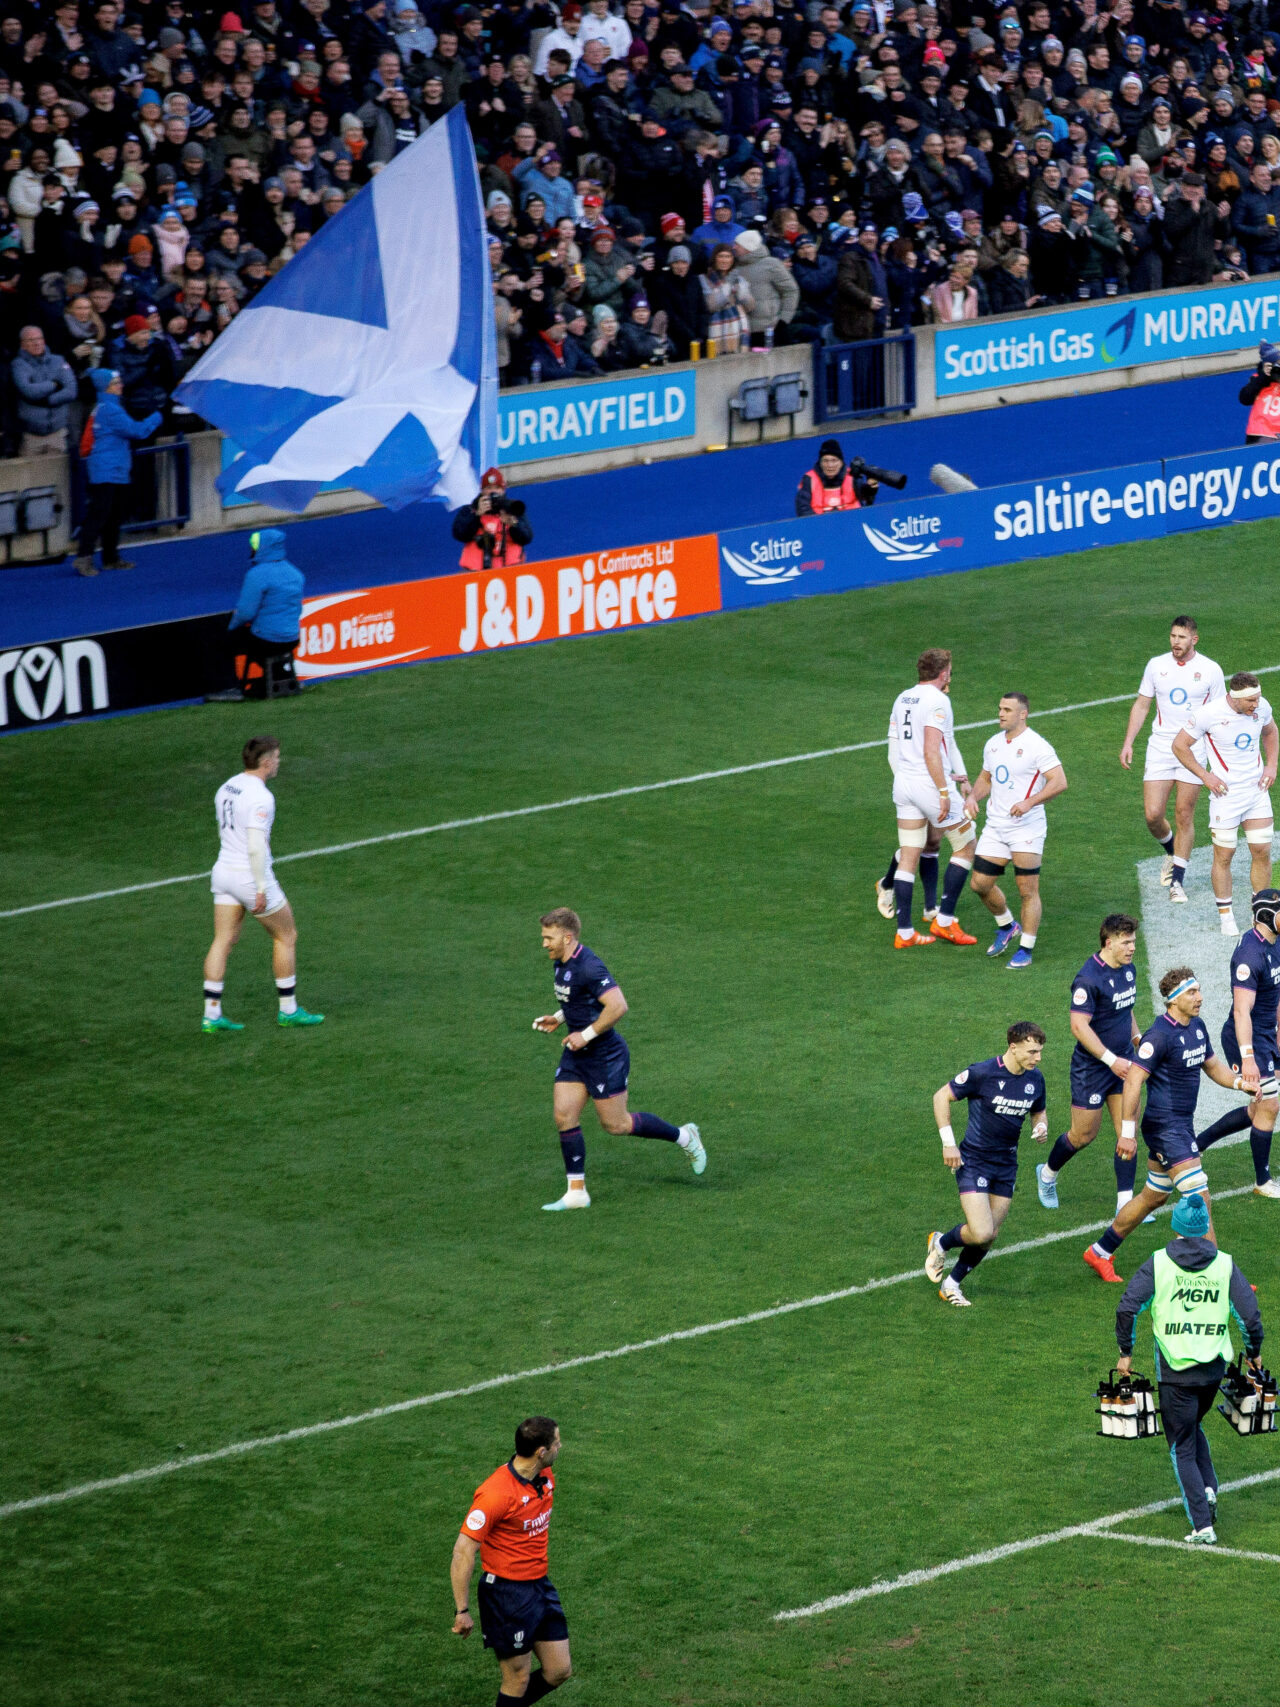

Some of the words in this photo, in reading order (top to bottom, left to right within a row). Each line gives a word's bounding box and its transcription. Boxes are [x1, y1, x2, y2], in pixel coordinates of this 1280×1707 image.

[944, 332, 1045, 380] Scottish
[1049, 327, 1094, 364] Gas
[497, 386, 687, 449] URRAYFIELD
[890, 514, 942, 541] Saltire
[598, 548, 654, 575] Contracts
[655, 541, 675, 565] Ltd
[750, 536, 803, 564] Saltire
[458, 574, 545, 653] J&D
[558, 558, 678, 636] Pierce
[297, 622, 336, 658] J&D
[340, 616, 396, 650] Pierce
[902, 709, 912, 740] 5
[991, 1095, 1034, 1109] Arnold
[994, 1105, 1030, 1117] Clark
[1164, 1322, 1227, 1336] WATER
